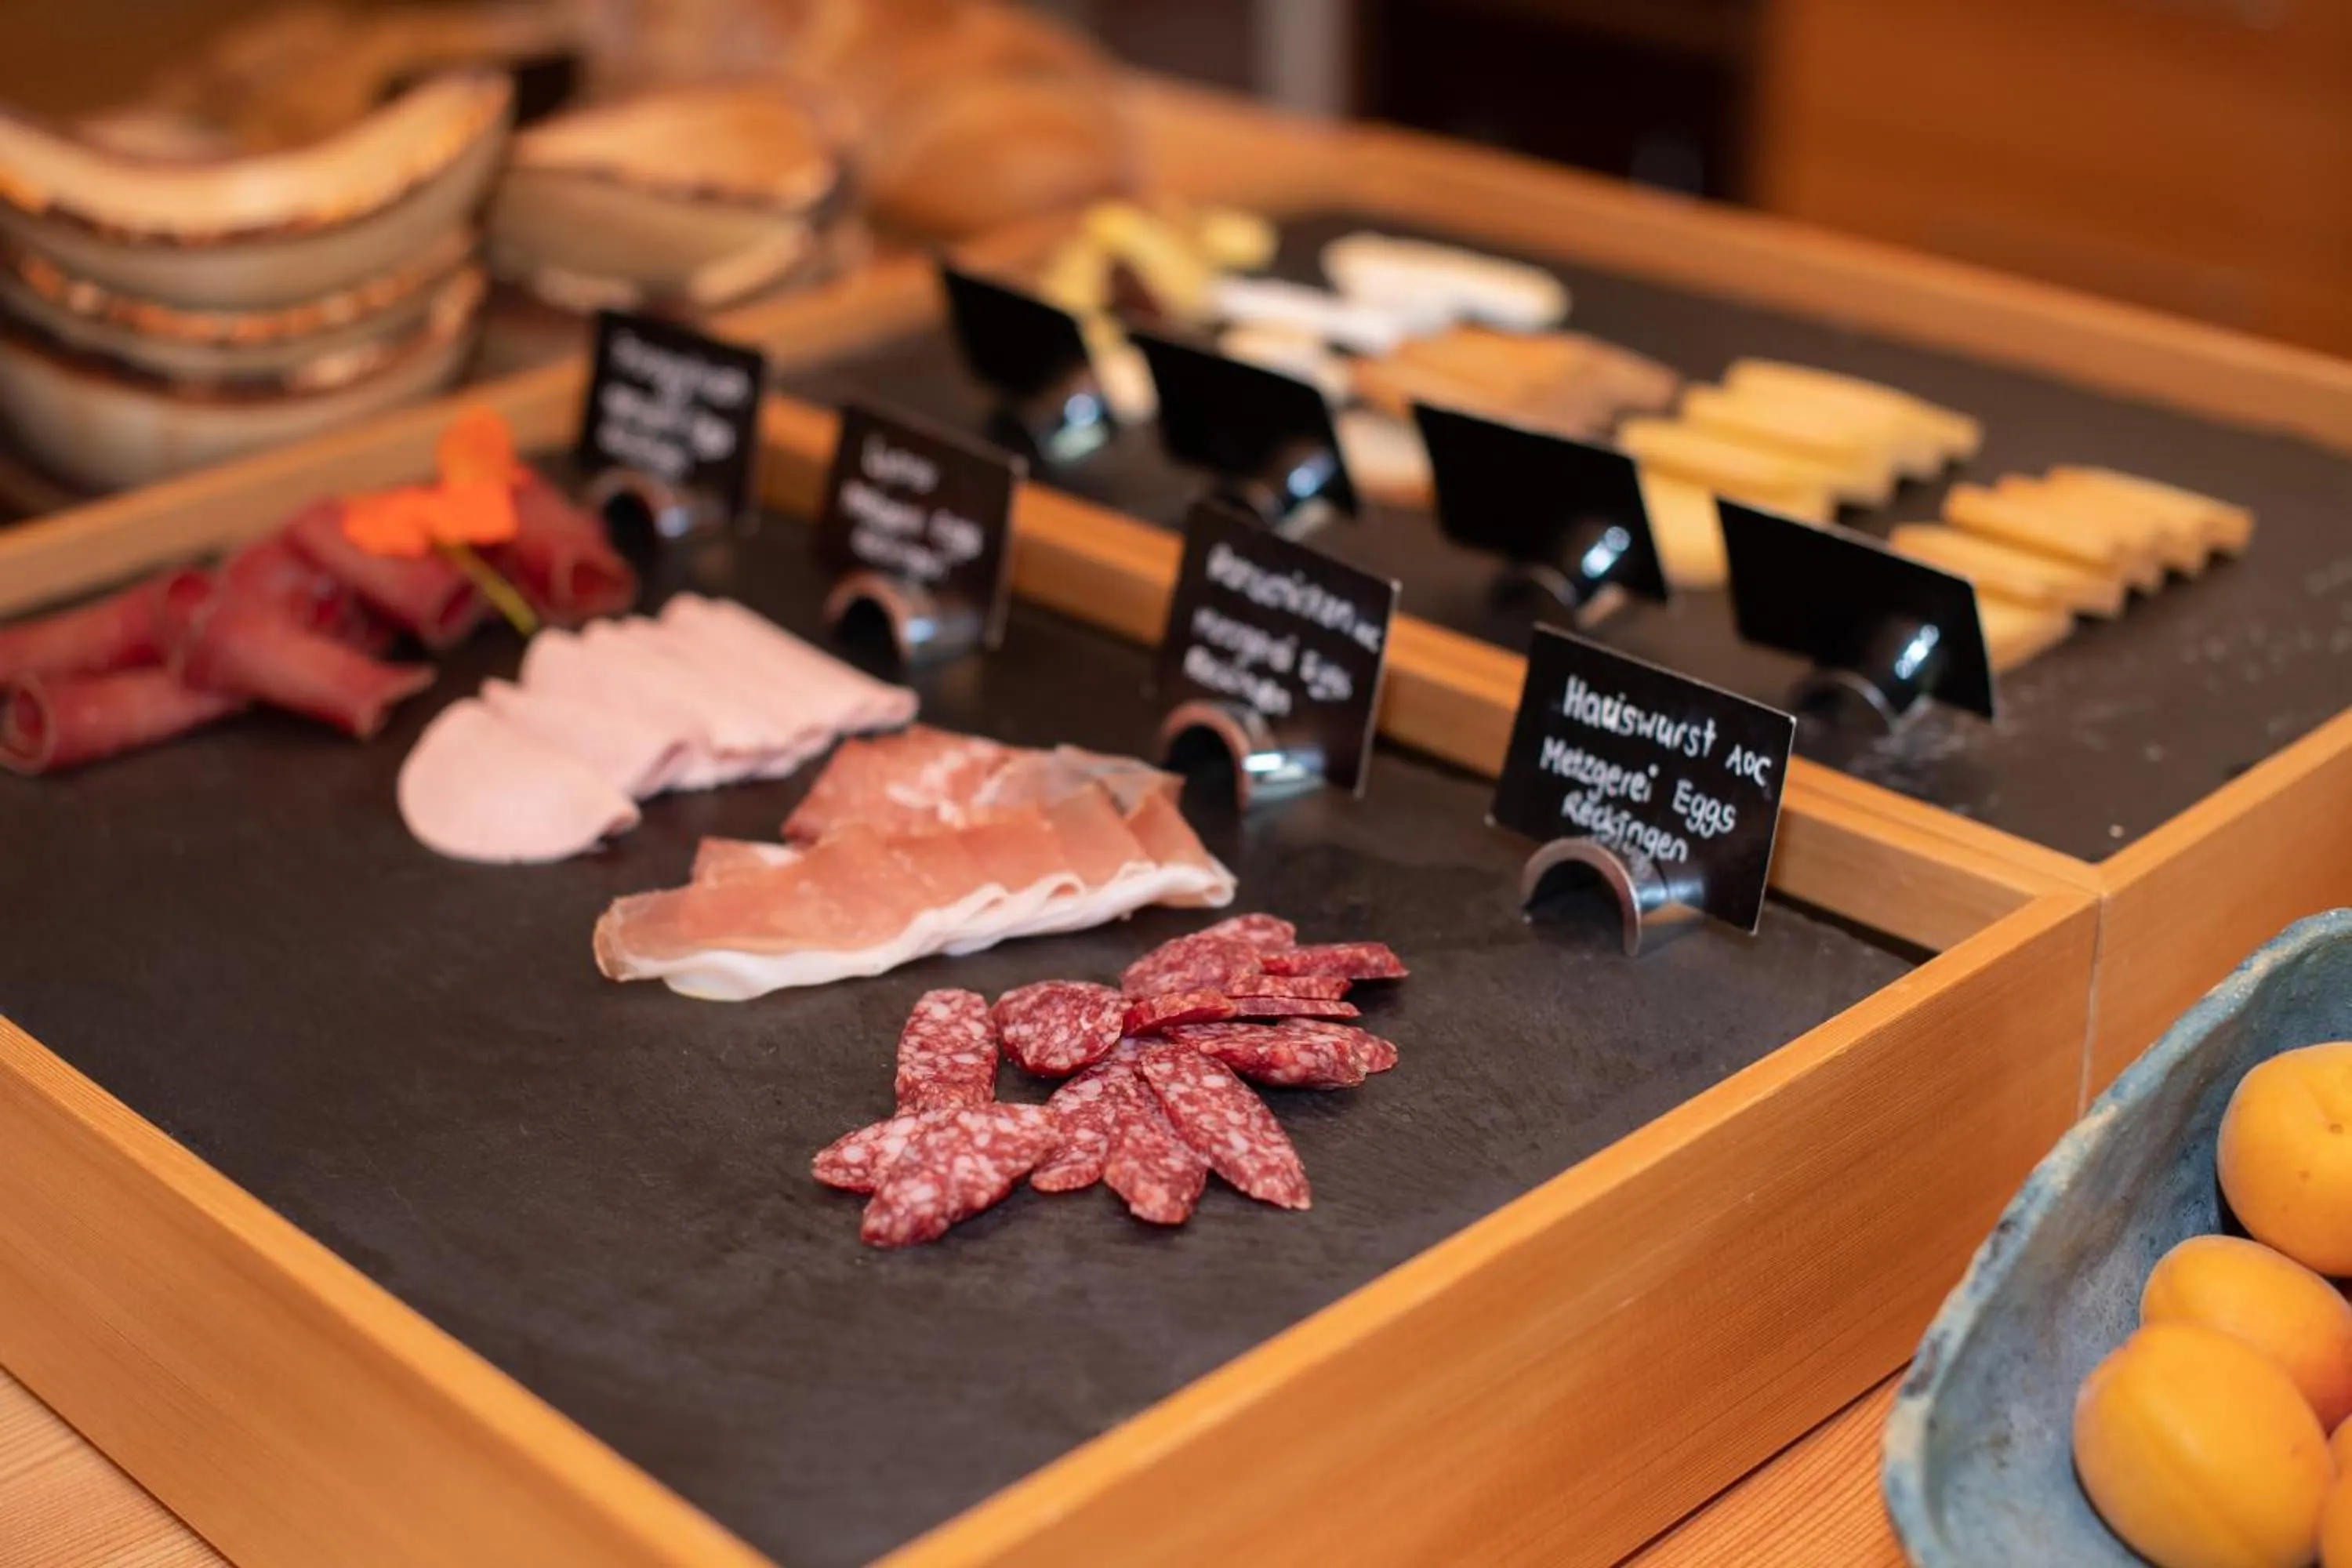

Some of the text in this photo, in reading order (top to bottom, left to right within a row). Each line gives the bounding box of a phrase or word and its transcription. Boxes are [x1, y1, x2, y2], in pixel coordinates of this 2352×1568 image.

[1539, 735, 1737, 838] Metzgerei Eggs
[1725, 744, 1773, 786] AOC
